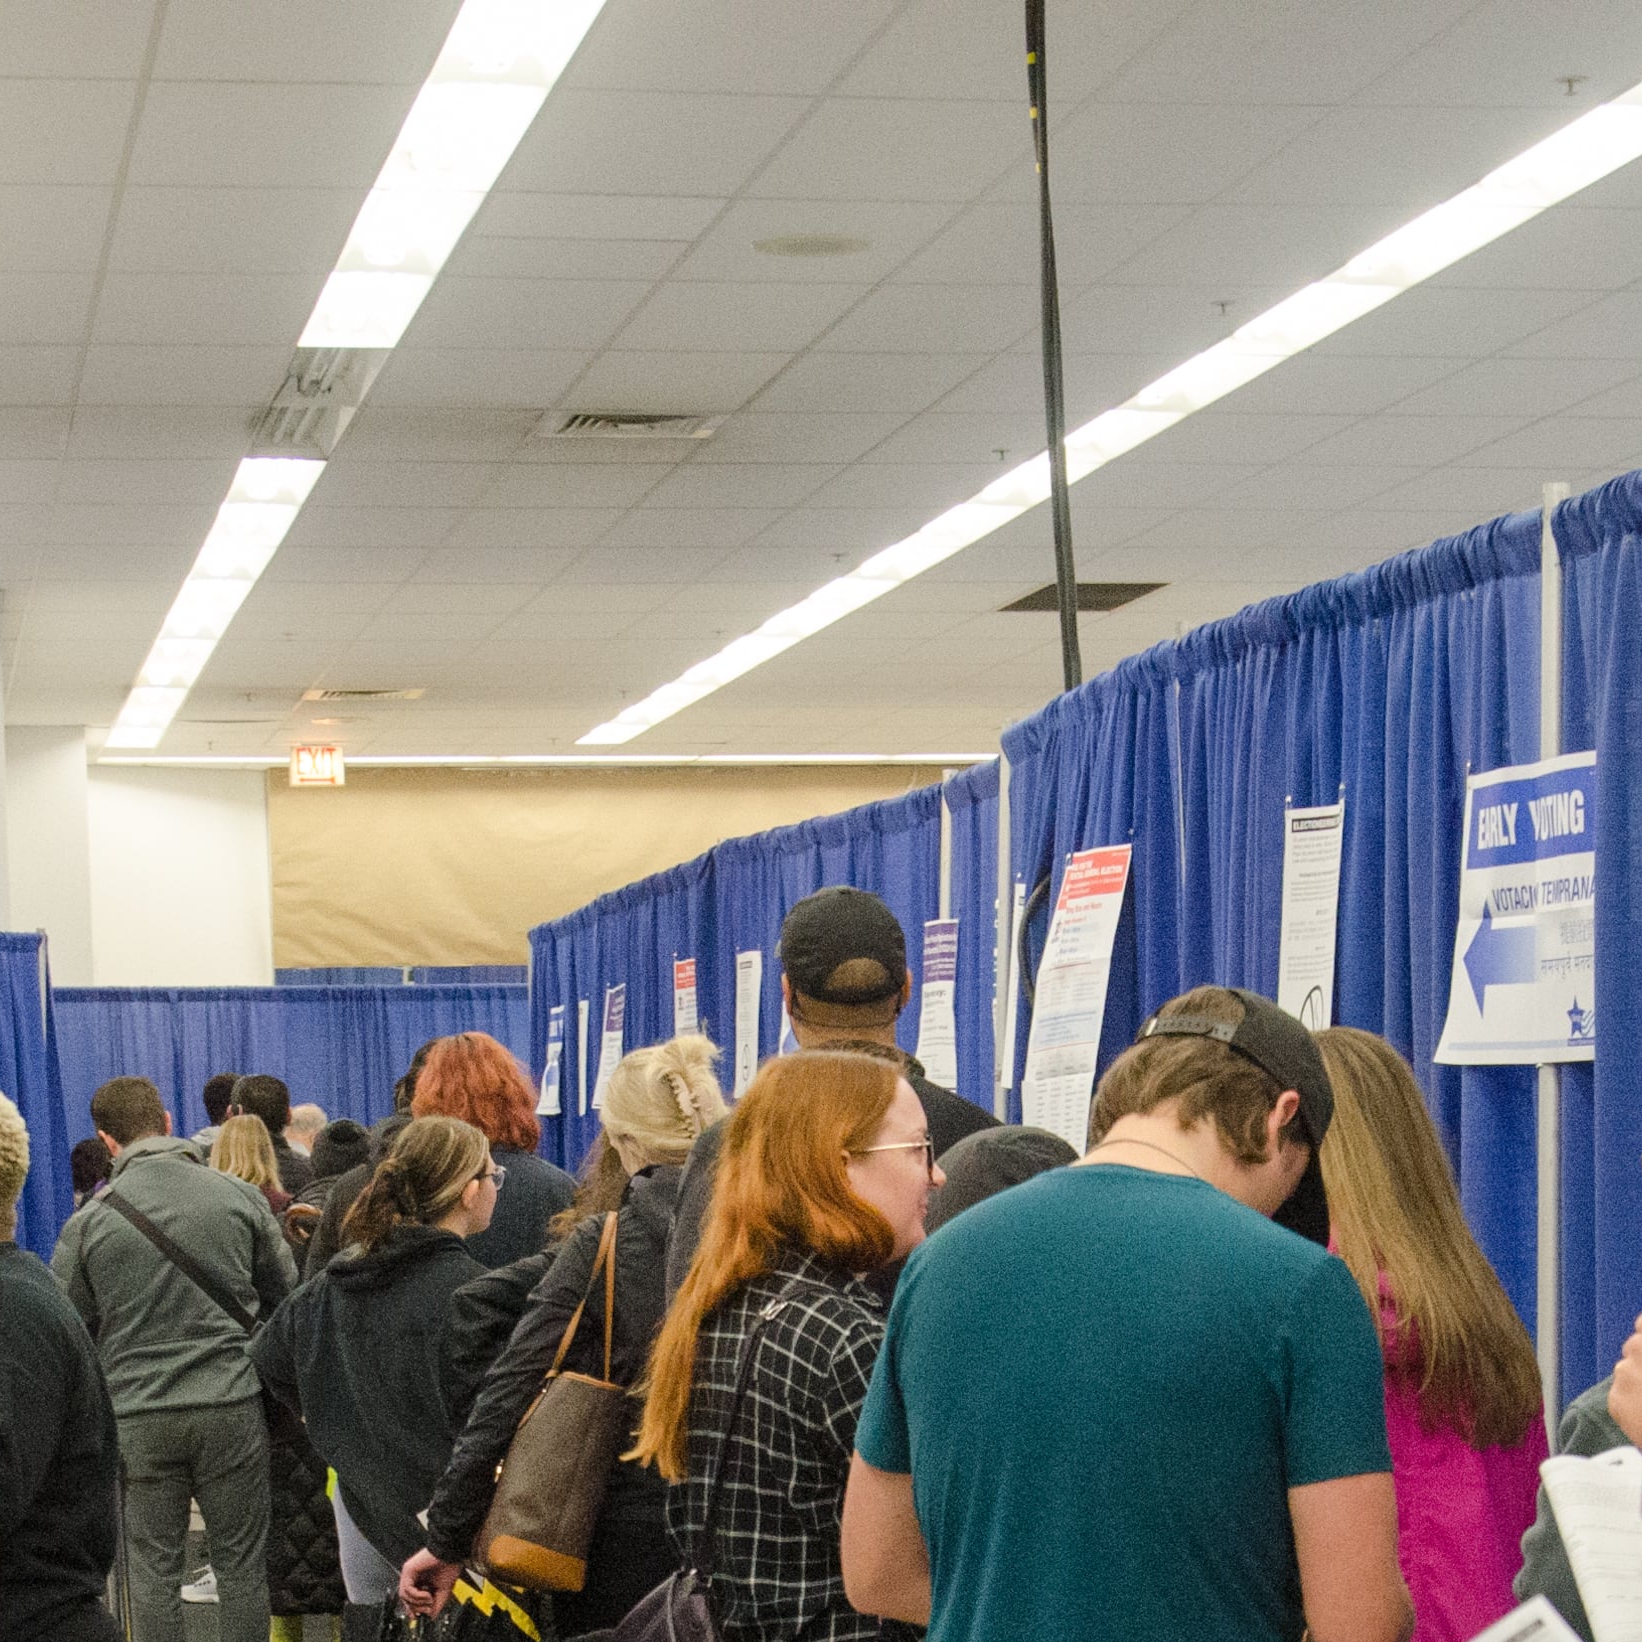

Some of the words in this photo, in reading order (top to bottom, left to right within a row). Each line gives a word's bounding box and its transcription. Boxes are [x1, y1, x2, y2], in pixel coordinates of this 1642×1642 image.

[297, 747, 336, 775] EXIT
[1477, 802, 1519, 850] EARLY
[1528, 790, 1585, 841] VOTING
